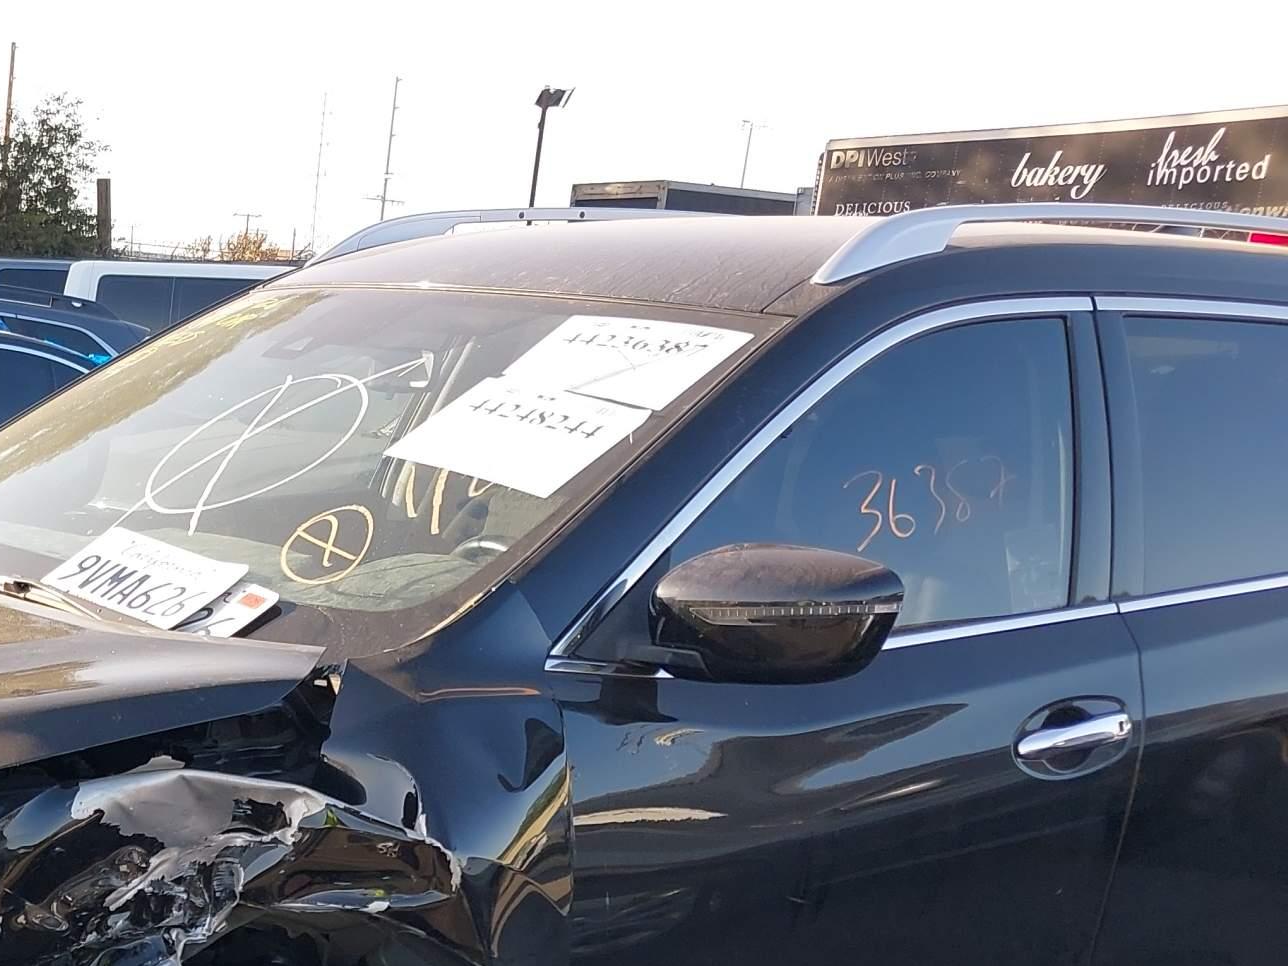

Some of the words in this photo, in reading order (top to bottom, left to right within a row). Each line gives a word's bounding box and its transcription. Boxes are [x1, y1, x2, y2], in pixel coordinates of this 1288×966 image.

[1011, 150, 1108, 200] bakery
[1146, 154, 1272, 190] imported
[1156, 127, 1227, 185] fresh
[834, 201, 911, 216] DELICIOUS
[58, 554, 208, 618] 9VMA626
